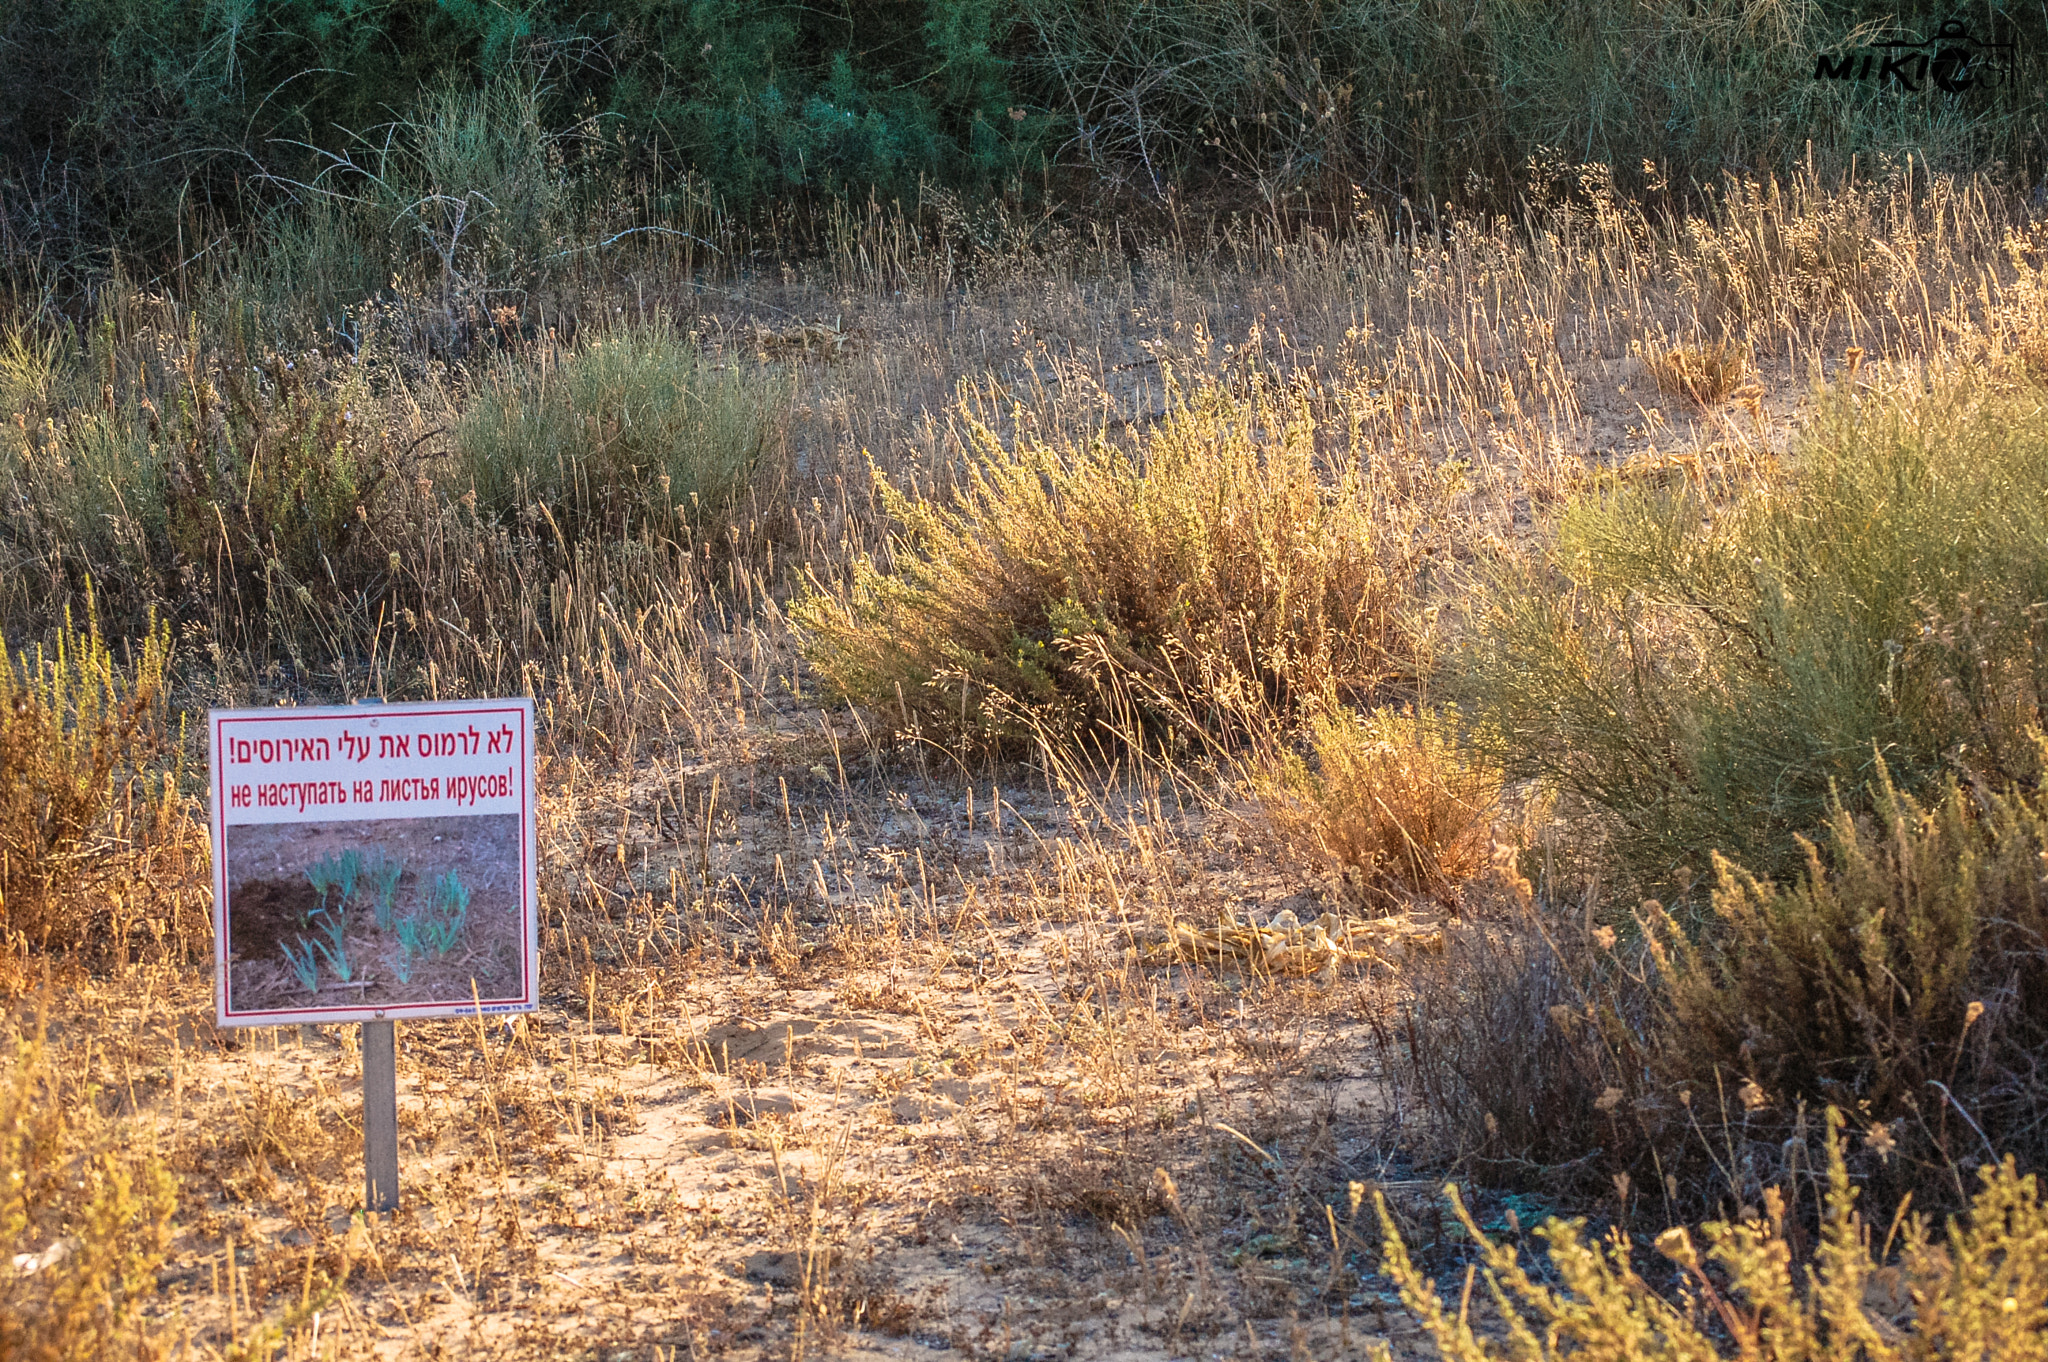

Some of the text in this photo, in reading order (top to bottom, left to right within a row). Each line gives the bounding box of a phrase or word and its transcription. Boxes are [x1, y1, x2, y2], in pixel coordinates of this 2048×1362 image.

[229, 723, 514, 764] לא לרמוס את עלי האירוסים!
[231, 766, 514, 813] не наступать на листья ирусов!
